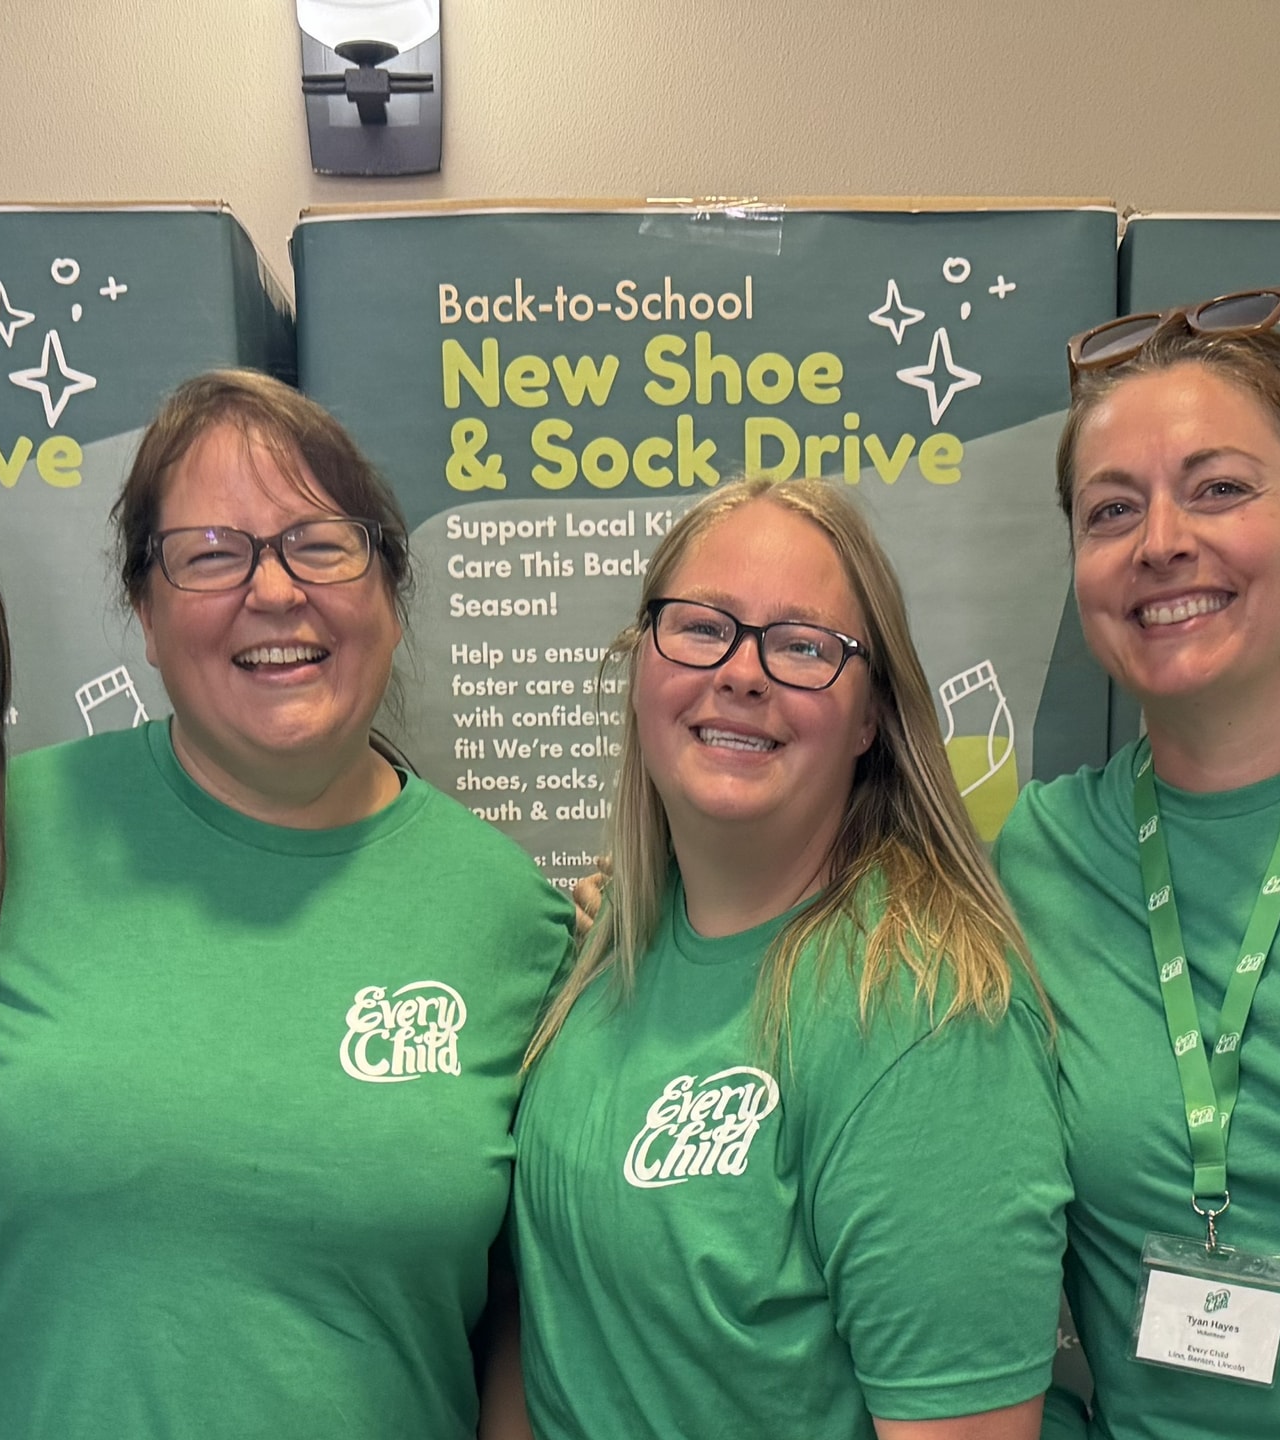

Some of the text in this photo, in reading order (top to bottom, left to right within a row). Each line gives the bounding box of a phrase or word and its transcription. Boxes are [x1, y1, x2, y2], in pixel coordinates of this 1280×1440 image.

[439, 277, 754, 325] Back-to-School
[442, 331, 844, 409] New Shoe
[445, 412, 964, 491] & Sock Drive
[447, 515, 557, 545] Support
[566, 510, 634, 537] Local
[448, 555, 512, 579] Care
[520, 551, 574, 577] This
[450, 592, 558, 617] Season!
[452, 642, 537, 669] Help us
[452, 674, 575, 696] foster care
[452, 705, 504, 728] with
[454, 738, 485, 759] fit!
[456, 768, 605, 793] shoes, socks,
[531, 801, 548, 820] &
[344, 978, 467, 1034] Every
[340, 1022, 461, 1082] Child
[647, 1068, 779, 1130] Every
[624, 1115, 760, 1187] Child
[1211, 1320, 1239, 1333] Hayes
[1187, 1344, 1229, 1359] Every Child
